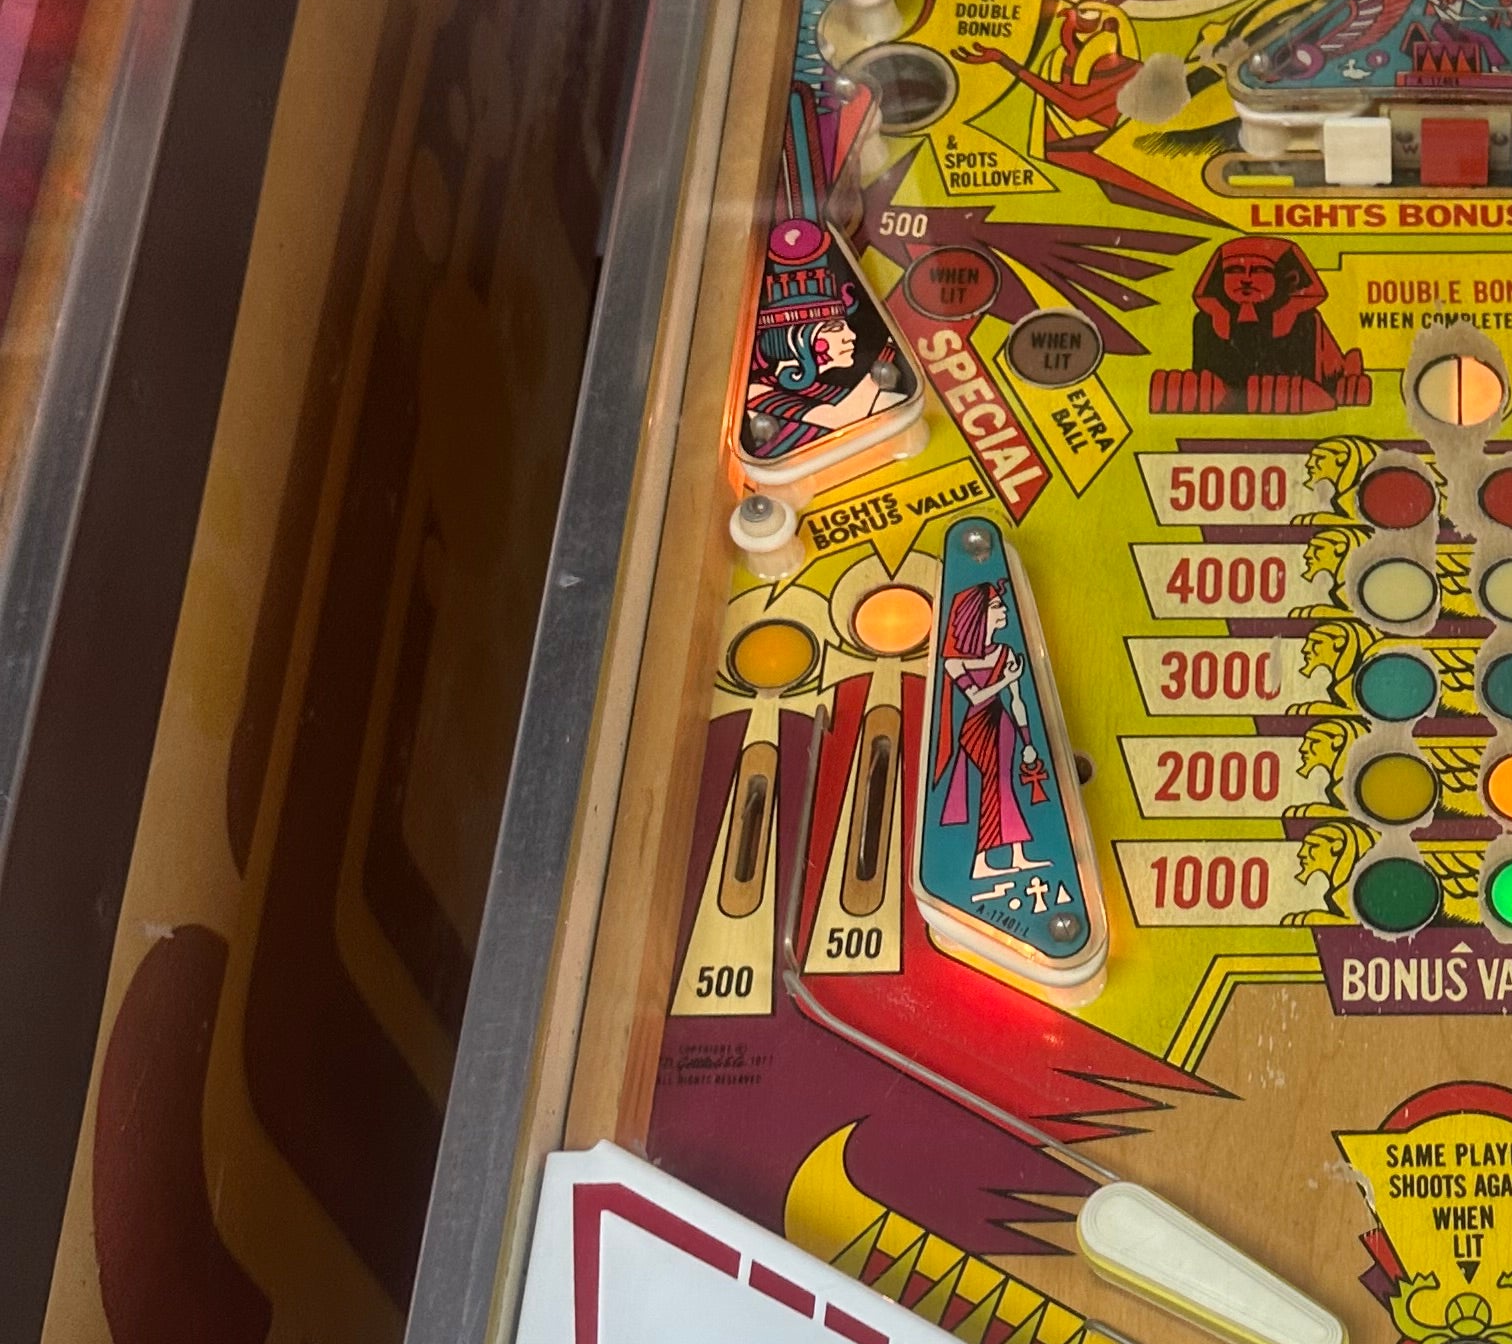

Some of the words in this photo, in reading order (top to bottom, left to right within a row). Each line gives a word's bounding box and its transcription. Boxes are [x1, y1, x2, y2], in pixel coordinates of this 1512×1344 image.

[955, 3, 1021, 20] DOUBLE
[957, 21, 1013, 38] BONUS
[946, 134, 958, 150] &
[944, 152, 998, 169] SPOTS
[950, 169, 1034, 188] ROLLOVER
[880, 211, 929, 238] 500
[1250, 204, 1386, 227] LIGHTS
[929, 267, 979, 284] WHEN
[940, 288, 967, 305] LIT
[1367, 280, 1461, 305] DOUBLE
[1359, 312, 1414, 329] WHEN
[1031, 332, 1082, 350] WHEN
[1043, 353, 1071, 371] LIT
[917, 329, 1044, 506] SPECIAL
[1066, 388, 1115, 453] EXTRA
[1050, 408, 1089, 455] BALL
[1169, 465, 1287, 512] 5000
[806, 492, 899, 537] LIGHTS
[811, 509, 904, 552] BONUS
[906, 479, 984, 516] VALUE
[1166, 556, 1287, 605] 4000
[1154, 750, 1280, 802] 2000
[1150, 855, 1270, 910] 1000
[826, 927, 883, 959] 500
[696, 965, 754, 998] 500
[1341, 957, 1470, 1003] BONUS
[1386, 1143, 1446, 1168] SAME
[1389, 1173, 1467, 1199] SHOOTS
[1432, 1205, 1494, 1231] WHEN
[1453, 1233, 1485, 1259] LIT
